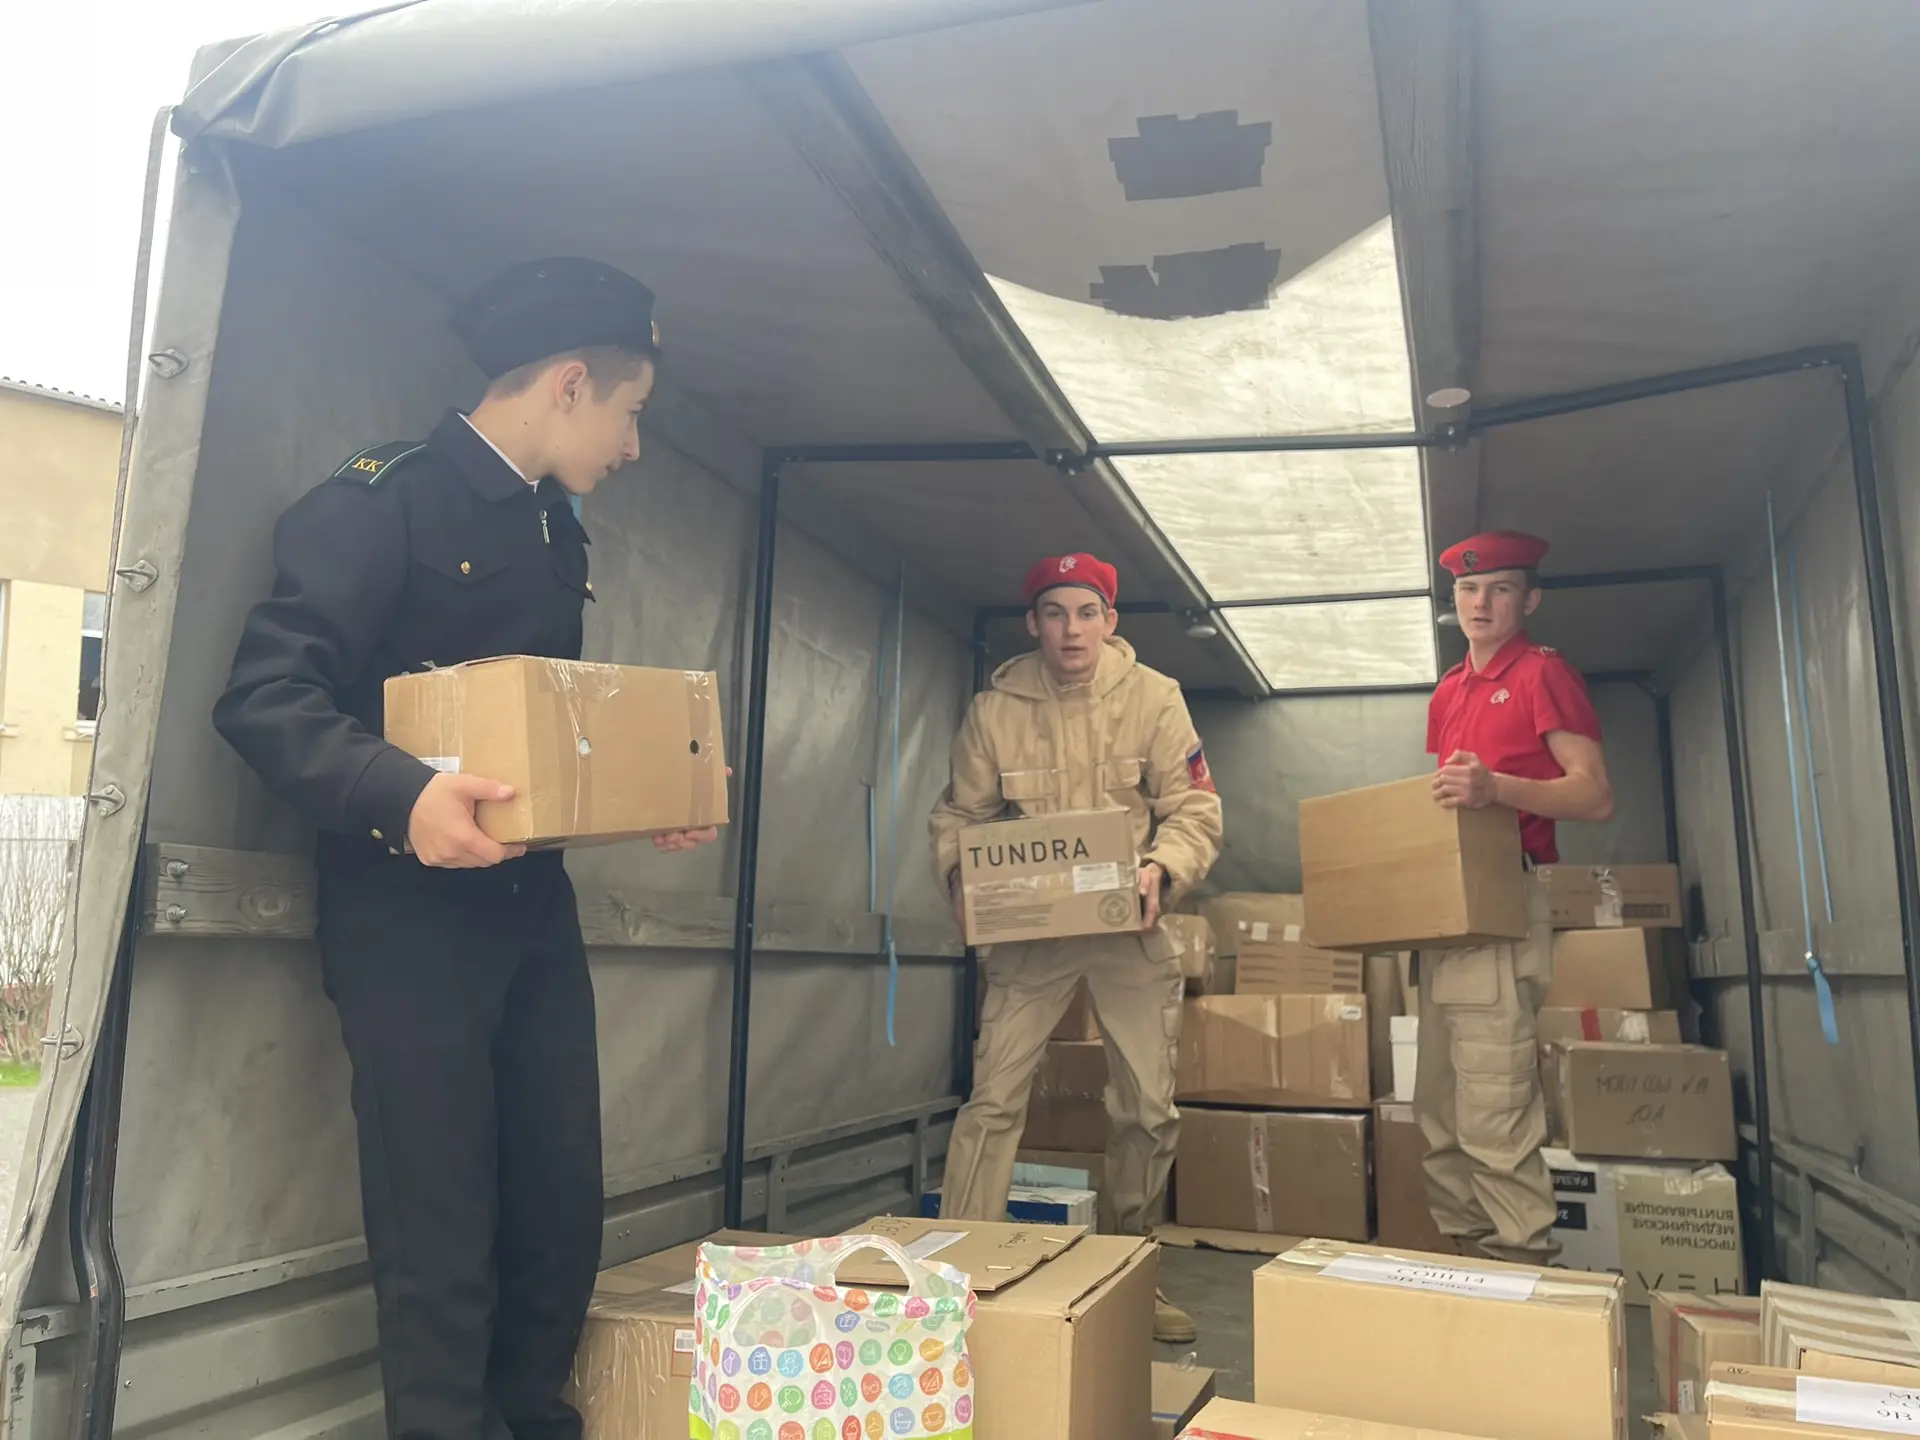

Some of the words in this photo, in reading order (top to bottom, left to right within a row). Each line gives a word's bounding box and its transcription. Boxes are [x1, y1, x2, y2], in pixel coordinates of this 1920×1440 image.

[968, 837, 1090, 869] TUNDRA
[1624, 1201, 1734, 1221] ВПИТЫВАЮЩИЕ
[1632, 1217, 1735, 1236] МЕДИЦИНСКИЕ
[1660, 1235, 1736, 1251] ПРОСТЫНИ
